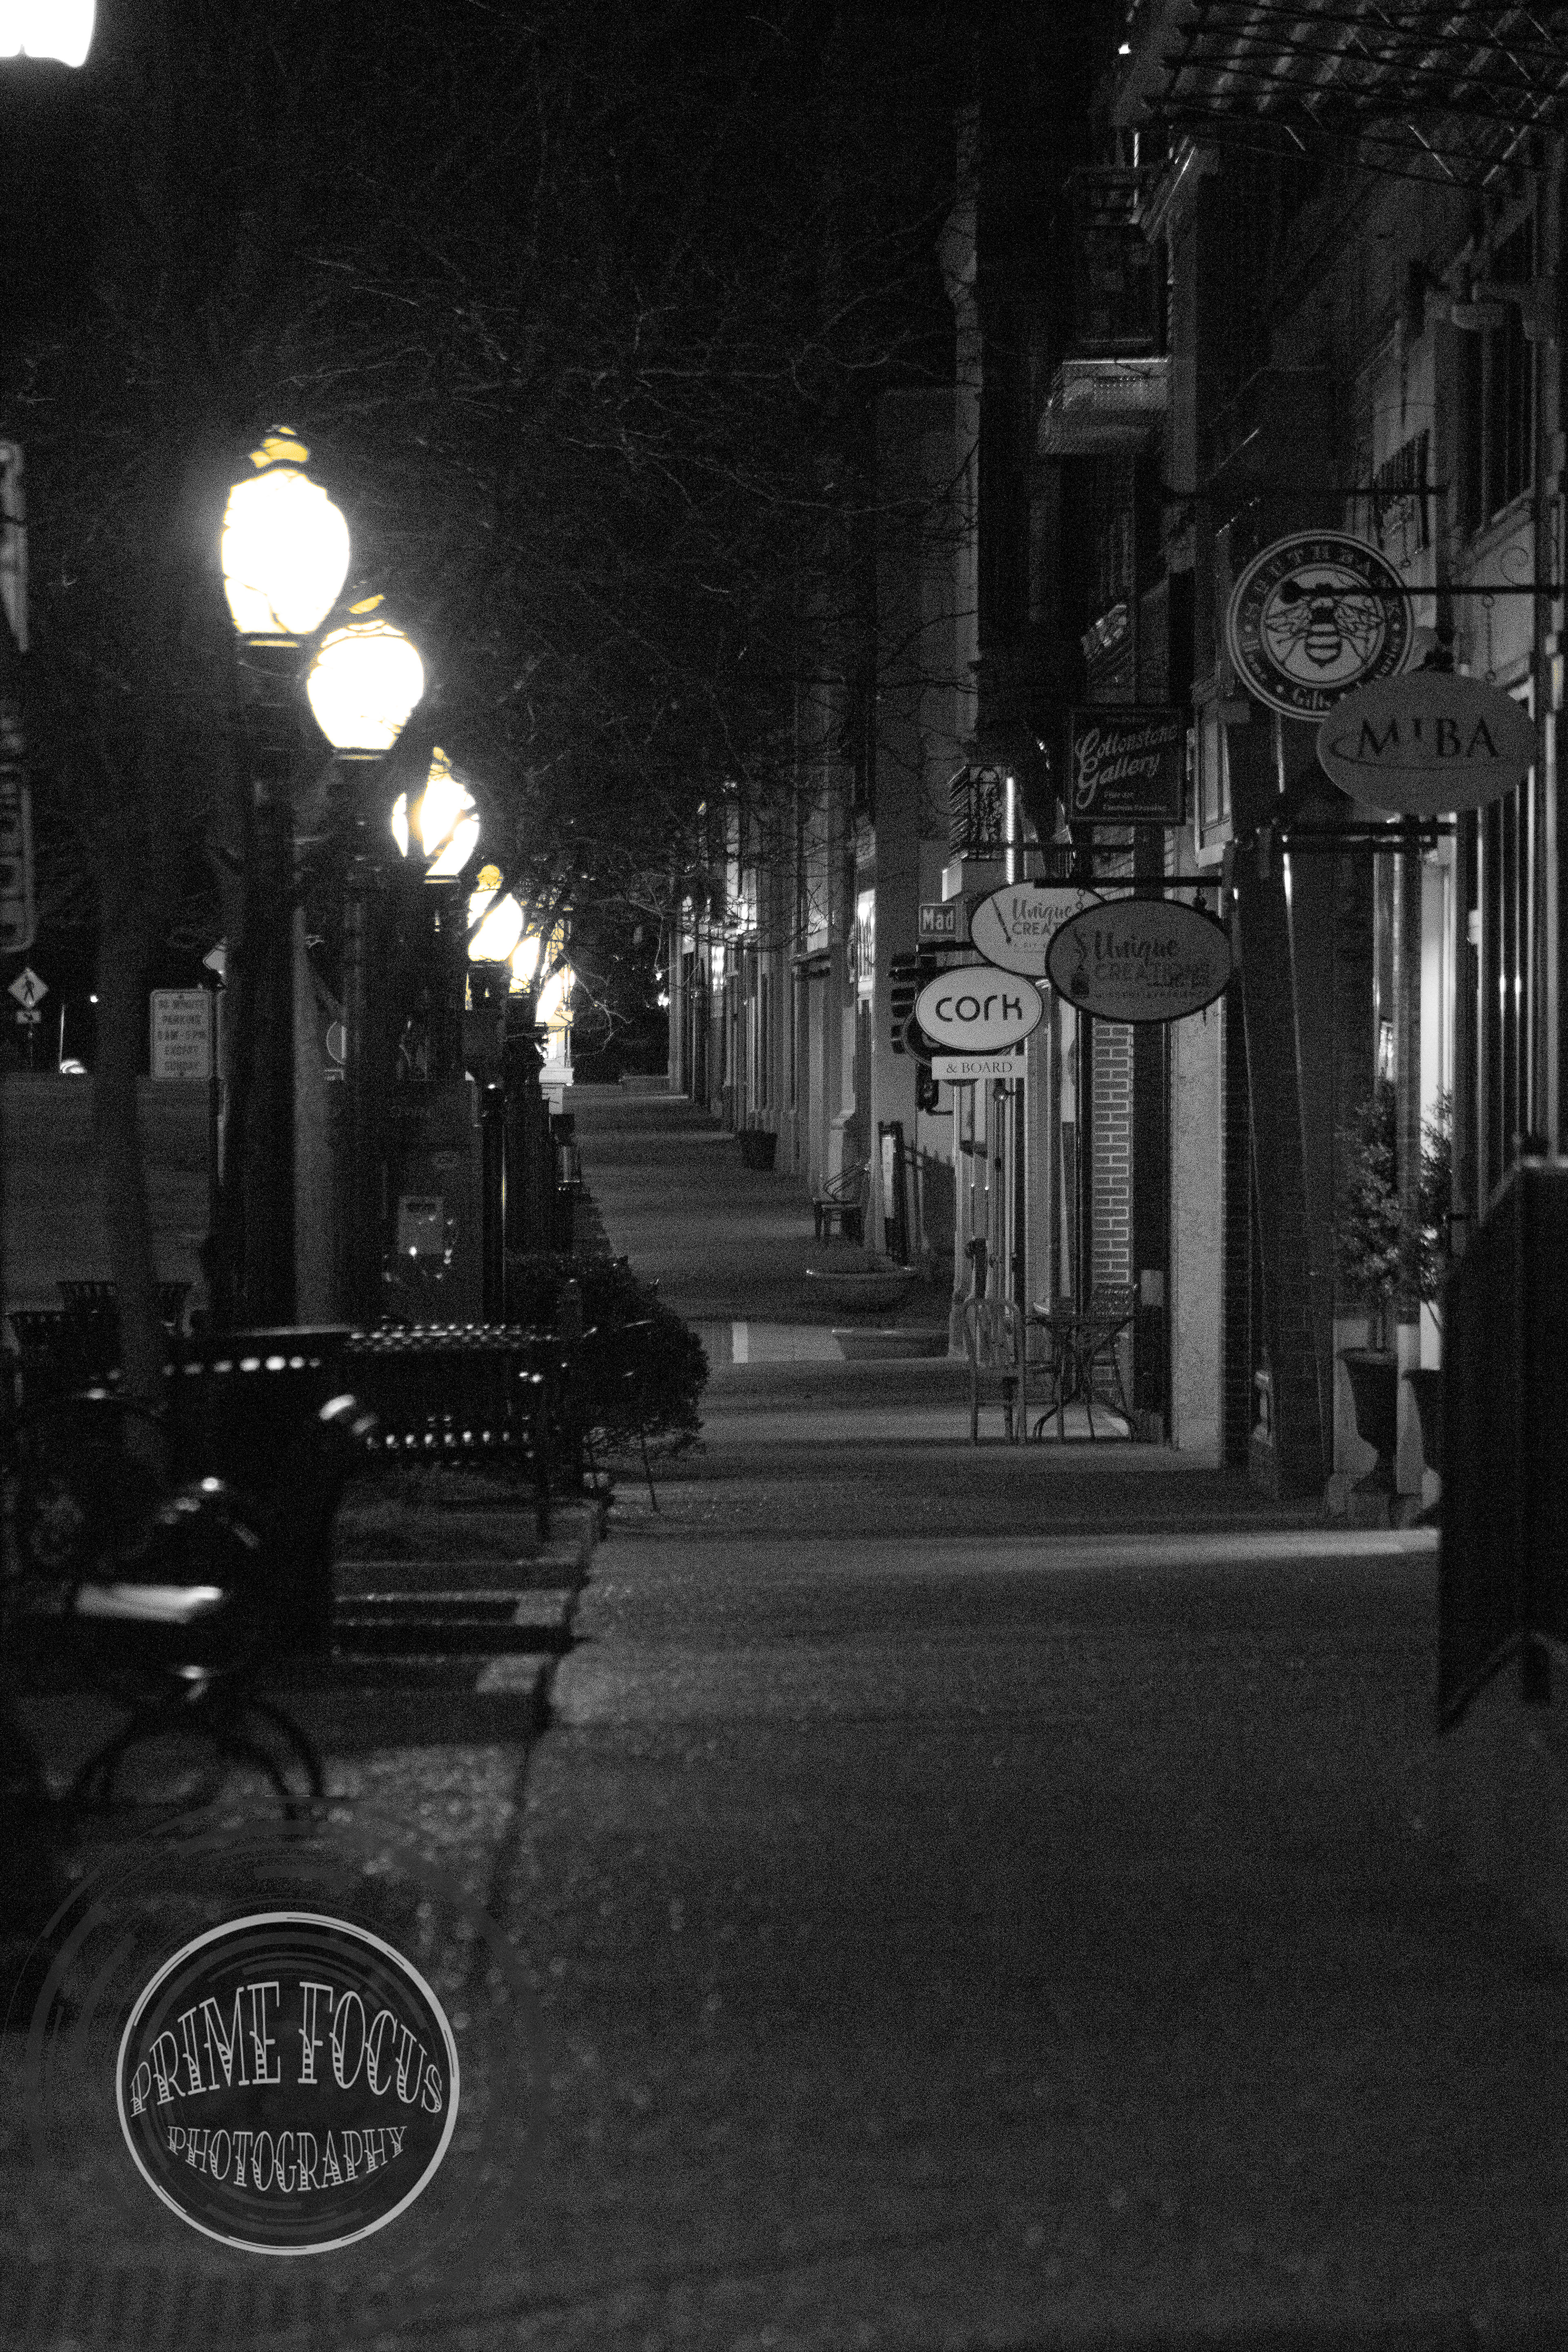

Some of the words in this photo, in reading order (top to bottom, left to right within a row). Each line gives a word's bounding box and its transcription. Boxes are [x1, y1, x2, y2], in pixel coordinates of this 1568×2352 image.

[1292, 688, 1332, 710] Gifts
[1076, 753, 1161, 810] Gallery
[923, 909, 954, 930] Mad
[1012, 898, 1072, 926] Unique
[1095, 930, 1178, 967] Unique
[946, 1063, 957, 1074] &
[962, 1061, 1013, 1074] BOARD
